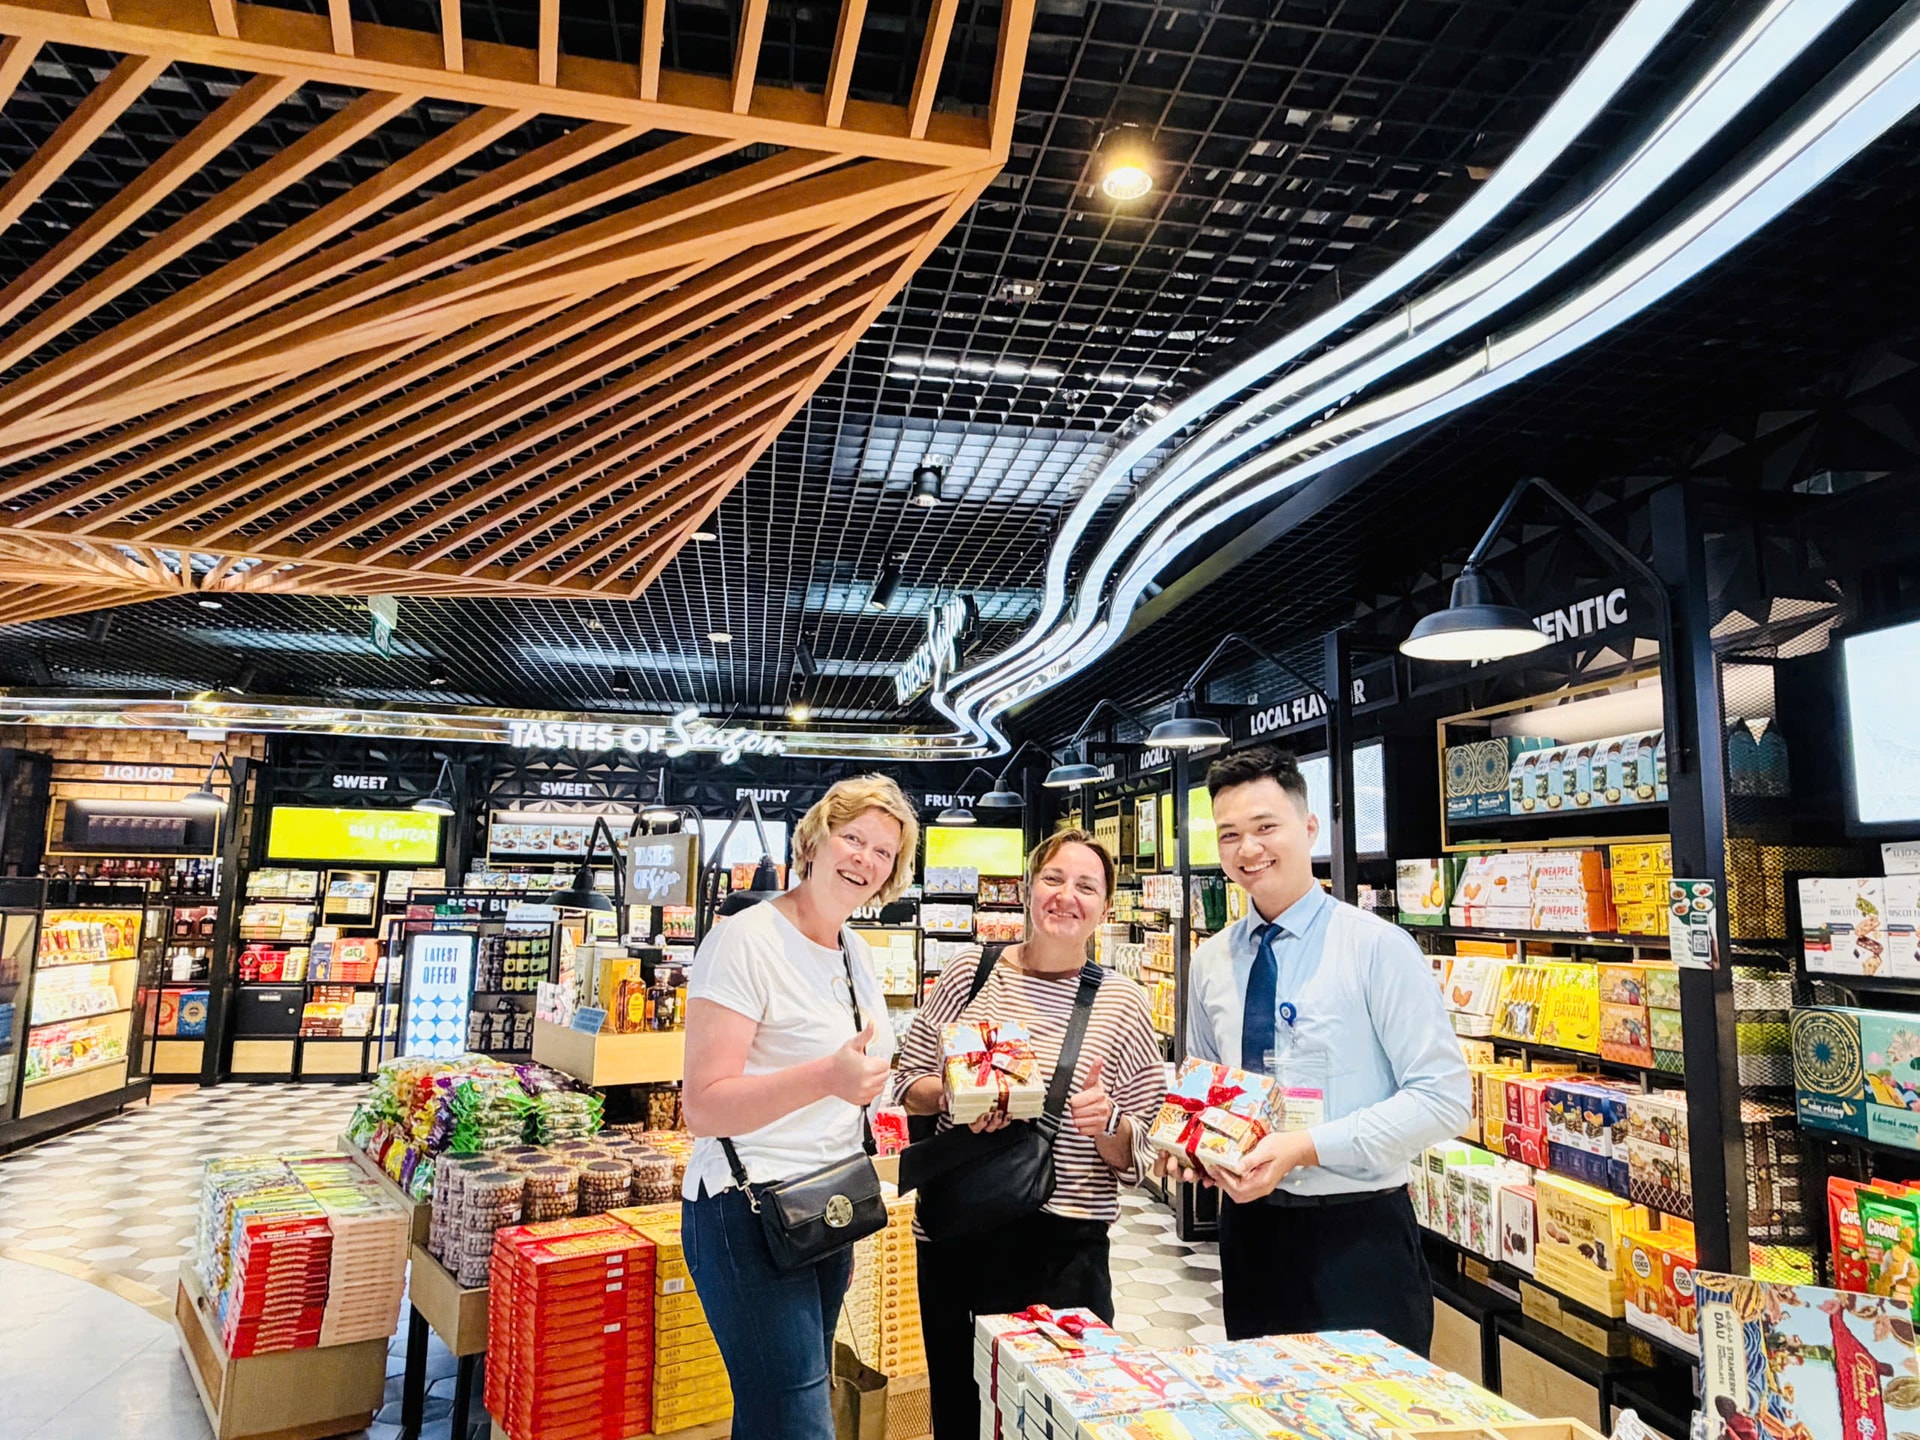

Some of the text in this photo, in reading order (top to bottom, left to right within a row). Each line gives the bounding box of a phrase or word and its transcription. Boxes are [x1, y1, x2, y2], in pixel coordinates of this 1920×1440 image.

[1250, 703, 1291, 736] LOCAL
[508, 708, 786, 765] TASTES OF Saigon
[103, 765, 175, 780] LIQUOR
[332, 774, 388, 790] SWEET
[540, 782, 594, 797] SWEET
[925, 794, 976, 808] FRUTY
[1538, 866, 1574, 879] PINEAPPLE
[1541, 905, 1579, 918] PINEAPPLE
[424, 947, 459, 963] LATEST
[423, 966, 457, 984] OFFER
[1554, 1000, 1590, 1021] BANANA
[1726, 1346, 1737, 1397] STRAWBERRY
